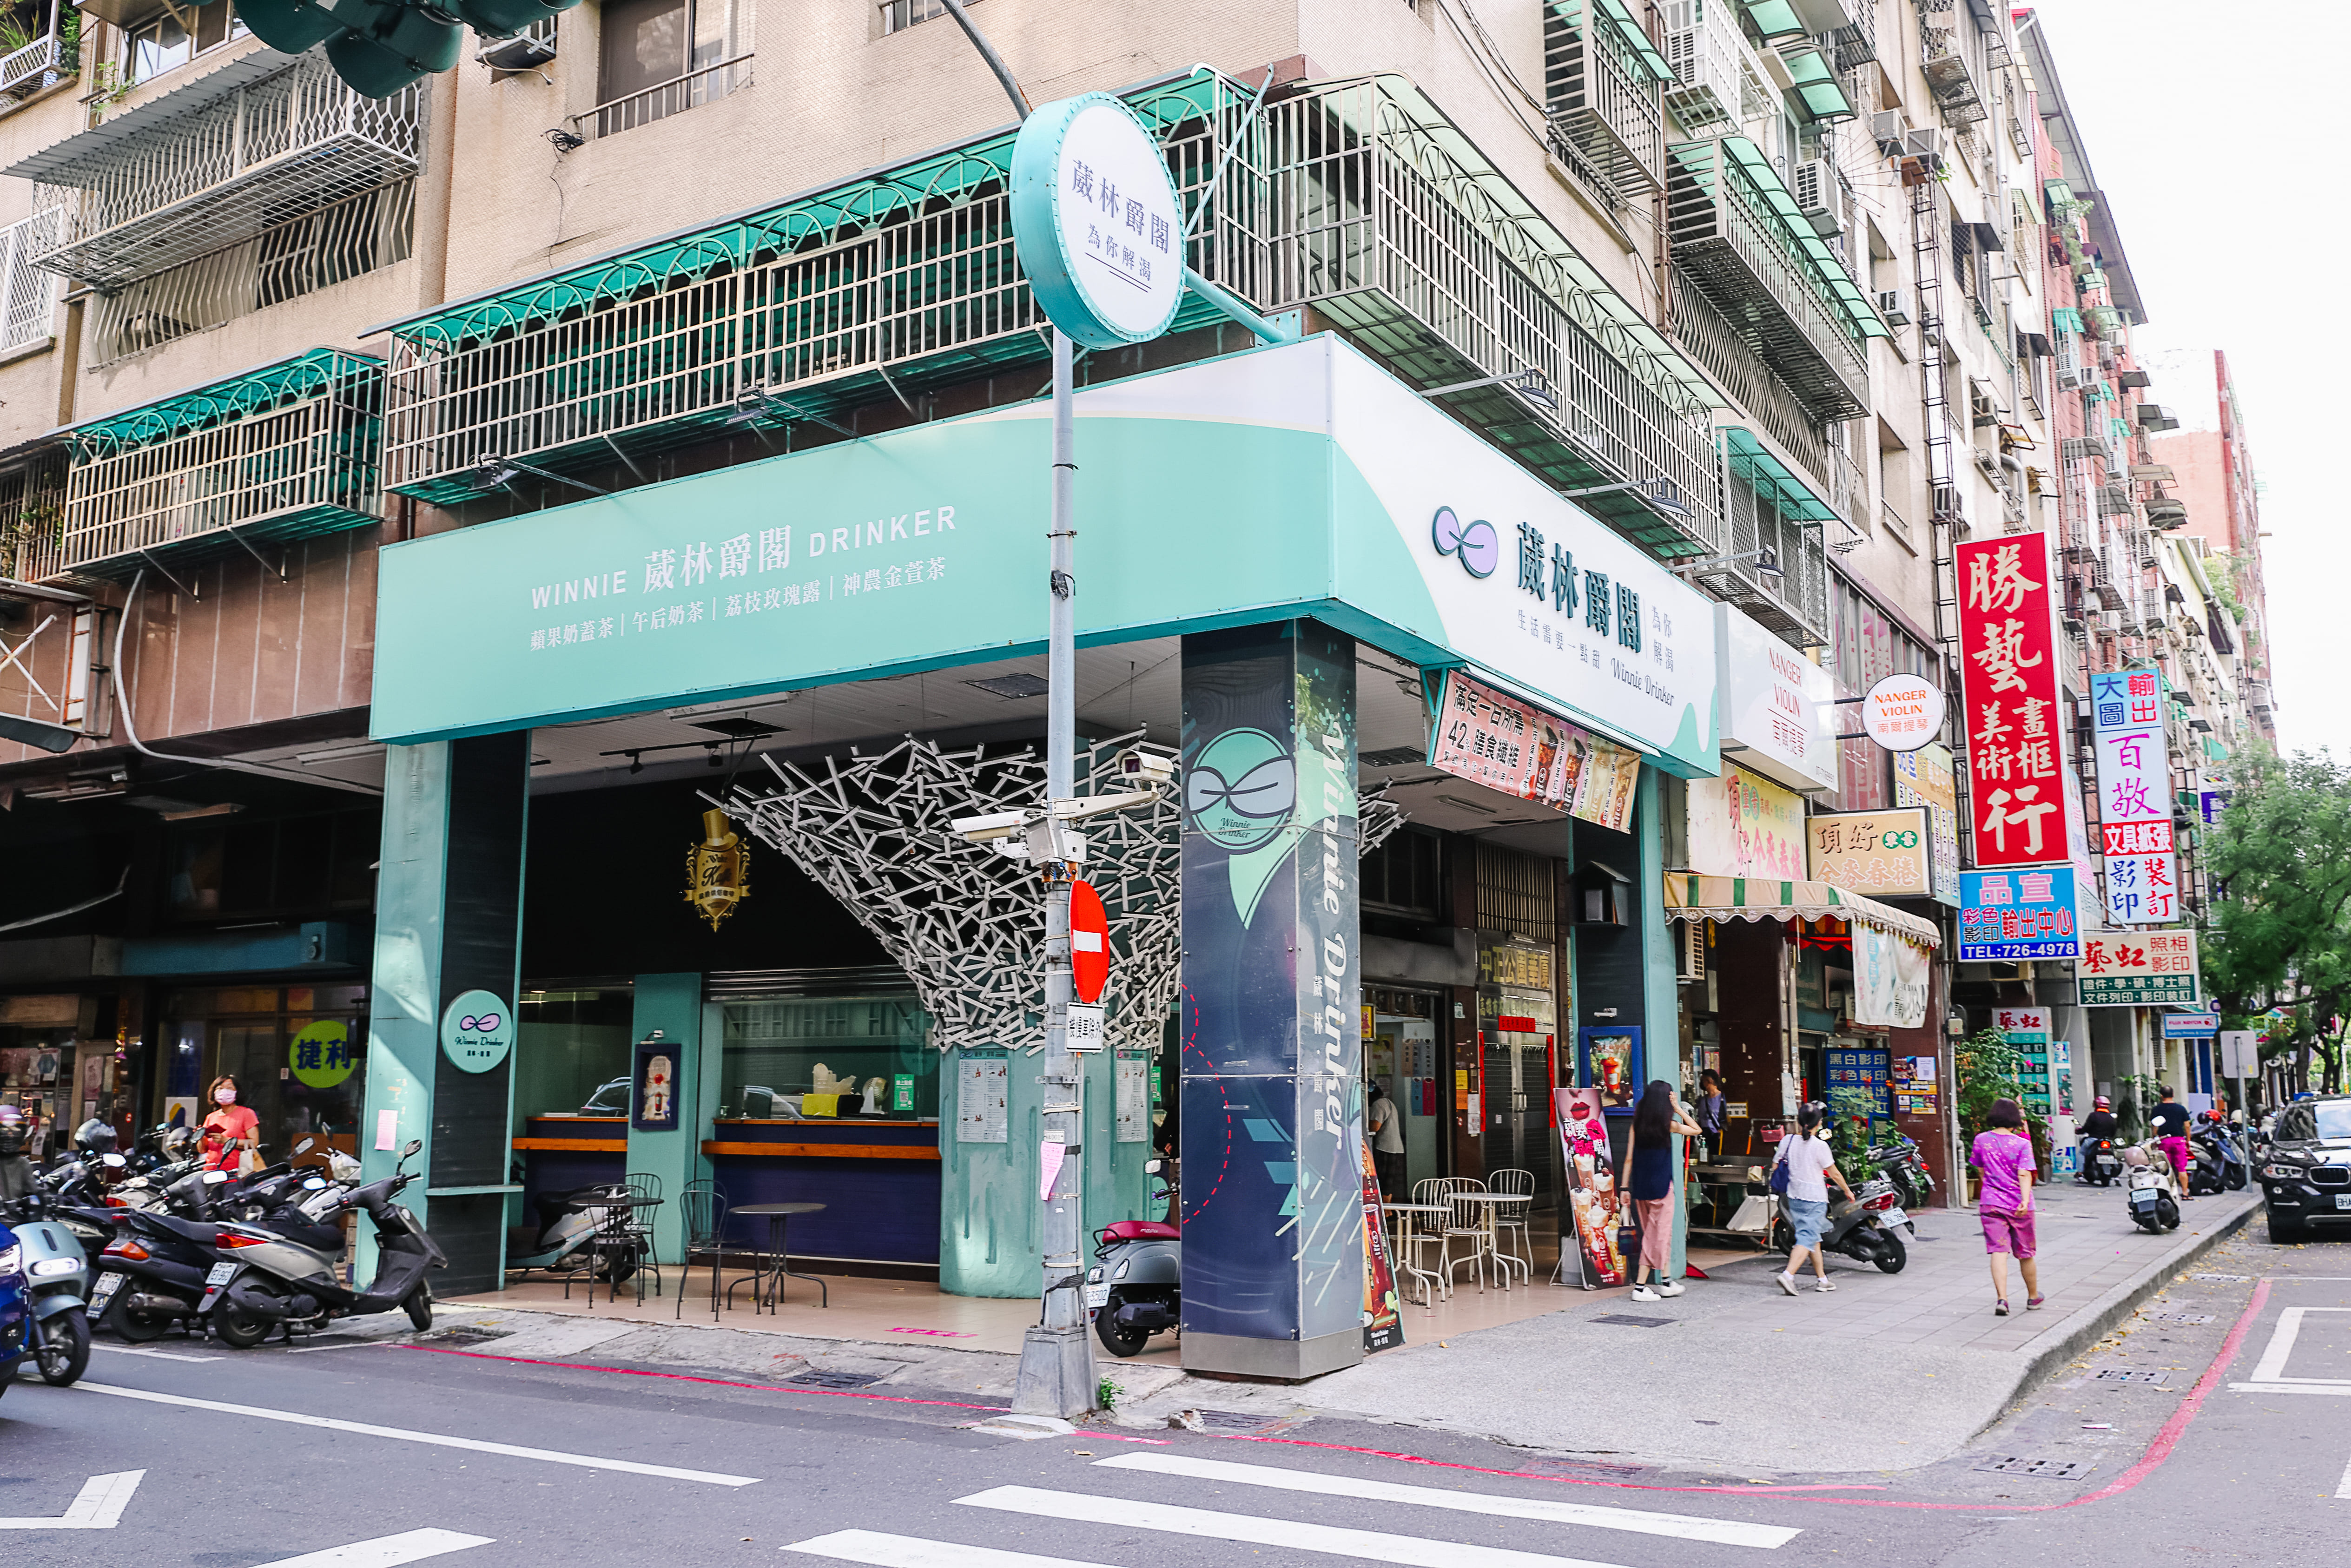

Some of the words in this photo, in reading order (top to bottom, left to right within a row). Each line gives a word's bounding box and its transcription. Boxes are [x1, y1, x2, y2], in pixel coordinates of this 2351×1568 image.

[1072, 158, 1169, 254] 葳林爵閣
[1087, 223, 1152, 282] 為你解渴
[531, 570, 627, 609] WINNIE
[642, 524, 792, 594] 葳林爵閣
[809, 505, 957, 557] DRINKER
[529, 617, 613, 651] 蘋果奶蓋茶
[632, 601, 704, 632] 午后奶茶
[724, 580, 820, 618] 荔枝玫瑰露
[842, 557, 946, 597] 神農金萱茶
[1516, 521, 1642, 654] 葳林爵閣
[1518, 608, 1600, 670] 生活需要一點甜
[1610, 658, 1642, 691] Winnie
[1644, 675, 1674, 707] Drinker
[1769, 647, 1802, 687] NANGER
[1774, 683, 1800, 718] VIOLIN
[1875, 690, 1926, 704] NANGER
[1882, 705, 1922, 717] VIOLIN
[2096, 675, 2126, 727] 大圖
[2127, 672, 2158, 724] 輸出
[1877, 718, 1928, 734] 南爾提琴
[2107, 732, 2161, 818] 百敬
[1218, 827, 1250, 838] Drinker
[1221, 817, 1251, 829] Winnie
[1323, 721, 1345, 915] Winnie
[1816, 821, 1878, 854] 頂好
[2105, 823, 2171, 854] 文具紙張
[1980, 873, 2054, 906] 品宣
[2110, 859, 2138, 919] 影印
[2144, 858, 2173, 917] 裝訂
[1962, 907, 1999, 925] 彩色
[2001, 906, 2074, 940] 輸出中心
[1963, 926, 2000, 943] 影印
[1965, 943, 2075, 958] TEL:726-4978
[2150, 936, 2188, 951] 照相
[2083, 940, 2147, 973] 藝虹
[2152, 956, 2190, 973] 影印
[1999, 1011, 2041, 1031] 藝虹
[297, 1038, 350, 1070] 捷利
[455, 1036, 477, 1045] Winnie
[1323, 933, 1347, 1151] Drinker
[1830, 1054, 1886, 1065] 黑白影印
[1830, 1070, 1887, 1080] 彩色影印
